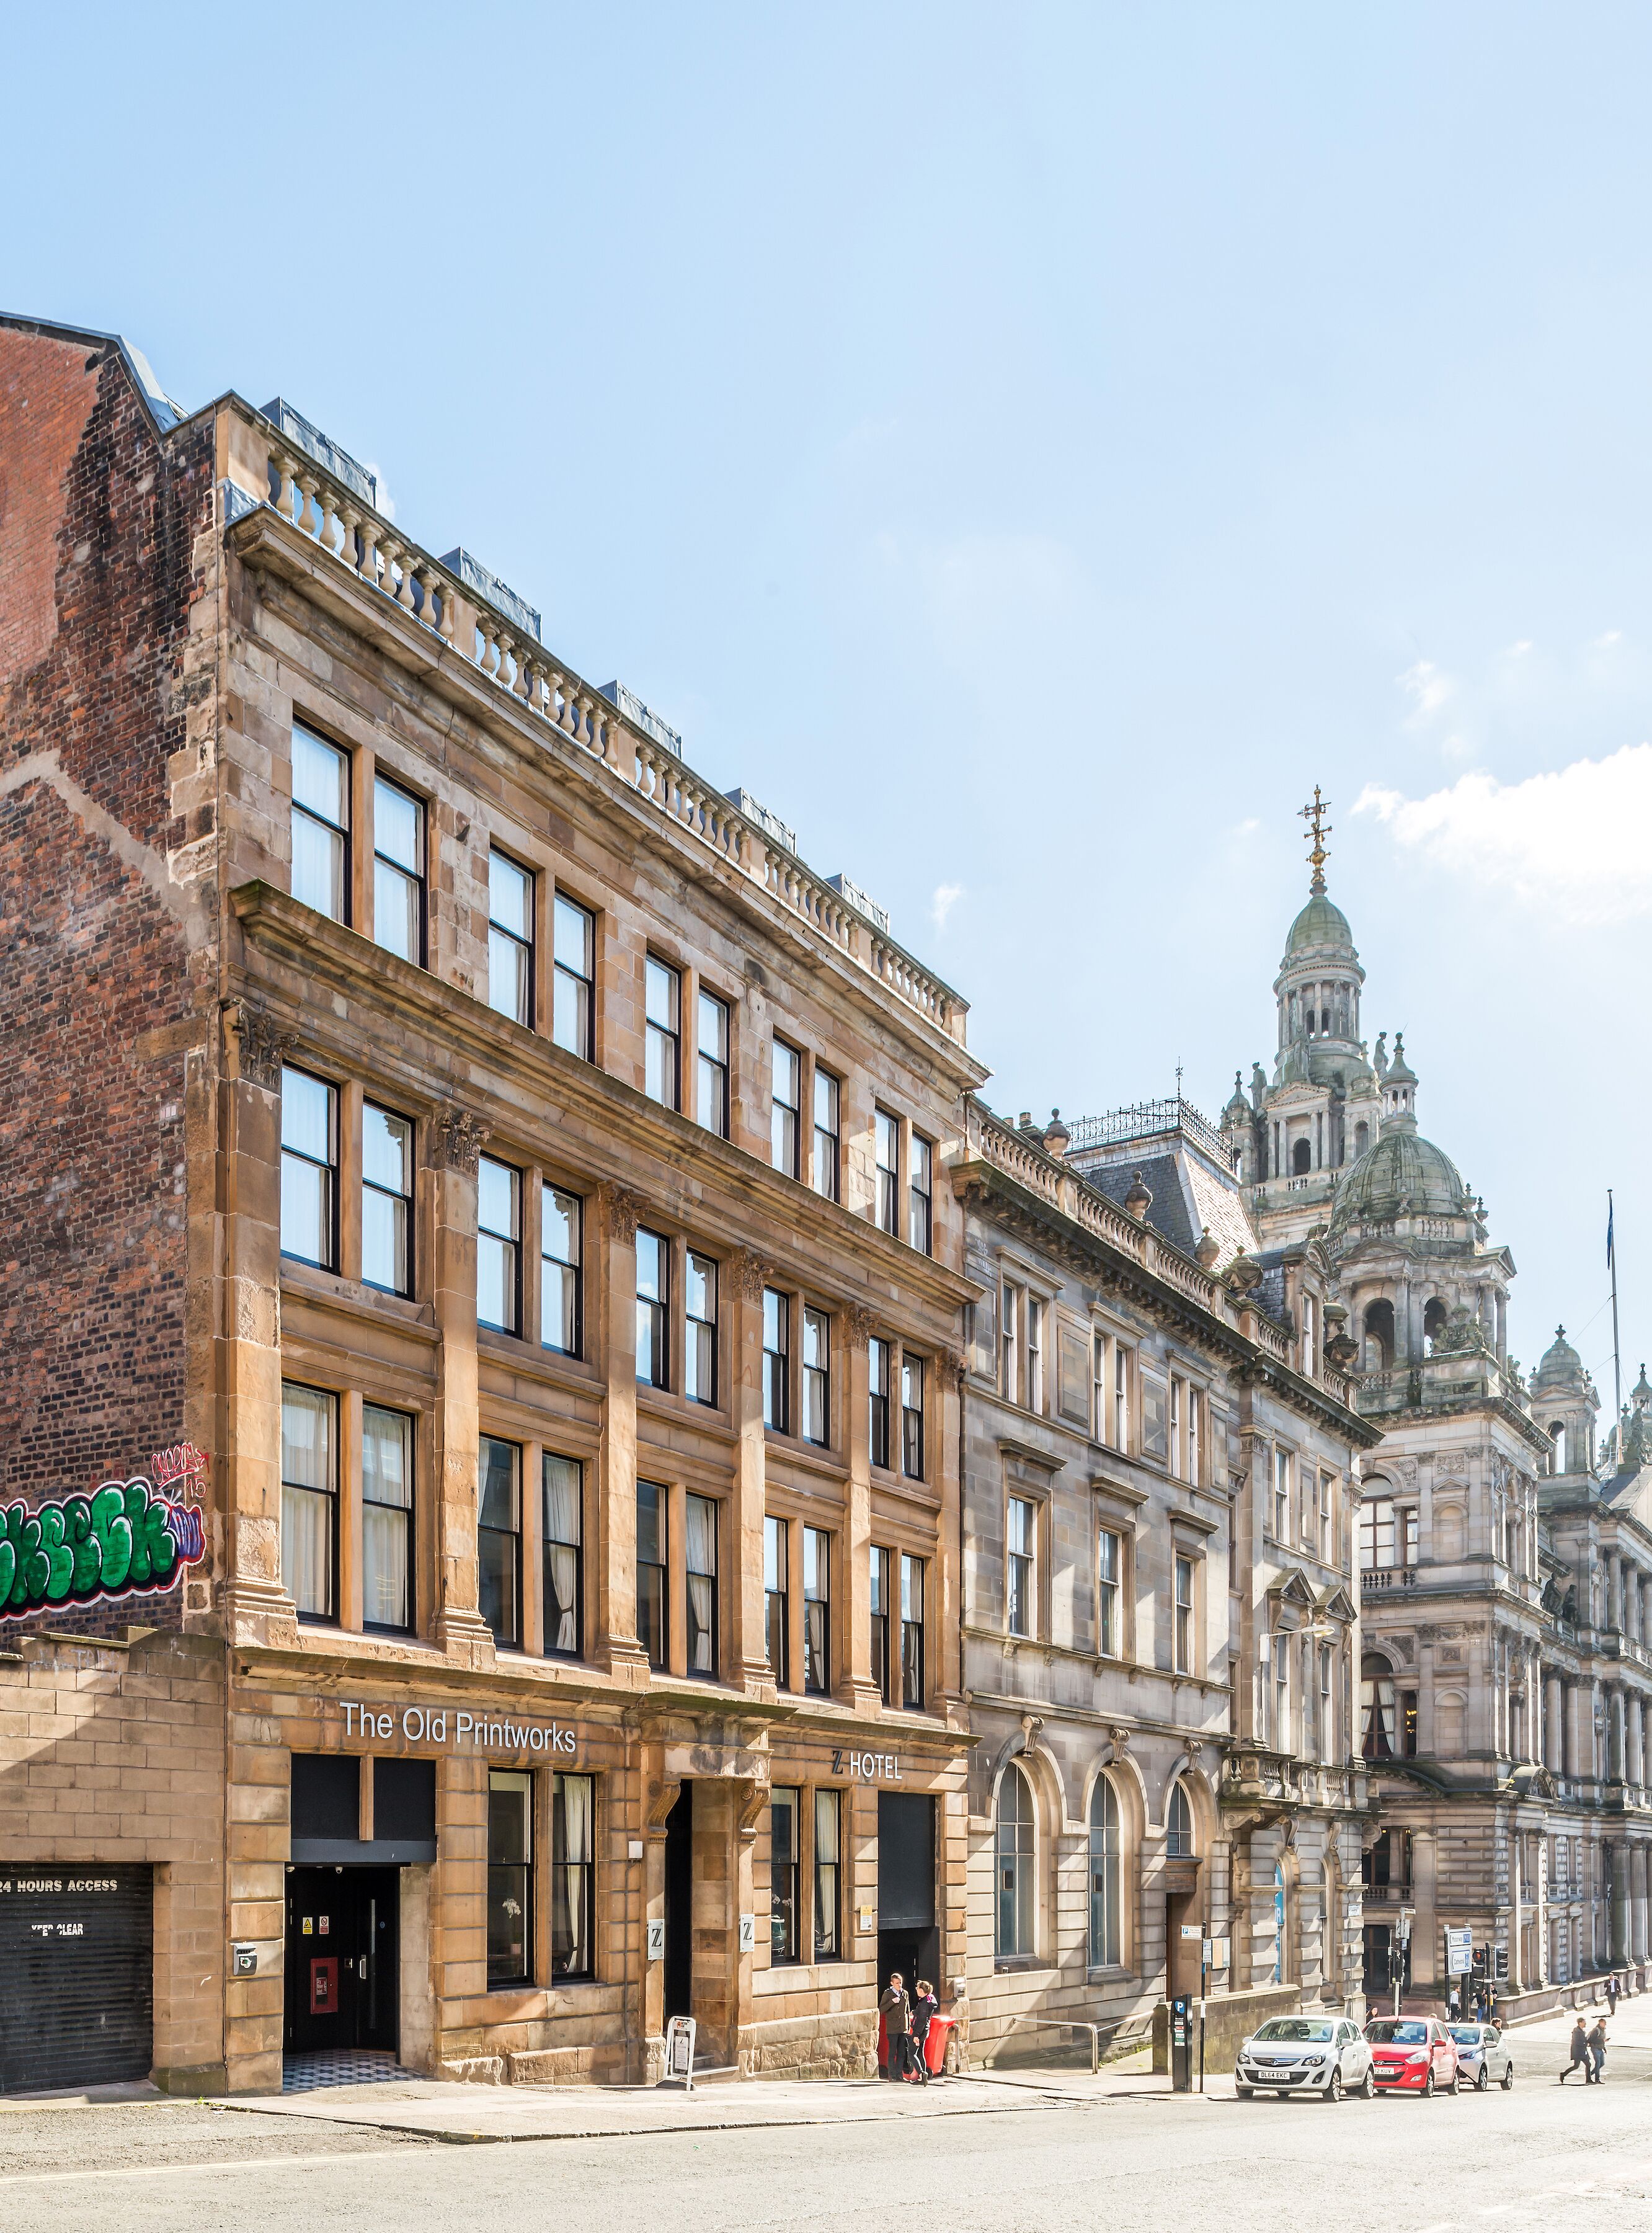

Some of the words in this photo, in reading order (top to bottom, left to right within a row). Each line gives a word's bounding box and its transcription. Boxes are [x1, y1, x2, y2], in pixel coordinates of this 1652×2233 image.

[186, 1475, 206, 1498] 15
[339, 1701, 393, 1739] The
[402, 1707, 446, 1742] Old
[456, 1712, 576, 1753] Printworks
[832, 1750, 843, 1774] Z
[850, 1752, 902, 1780] HOTEL
[17, 1880, 62, 1892] HOURS
[67, 1879, 118, 1891] ACCESS
[652, 1928, 662, 1947] Z
[744, 1923, 752, 1940] Z
[1177, 2002, 1184, 2012] P
